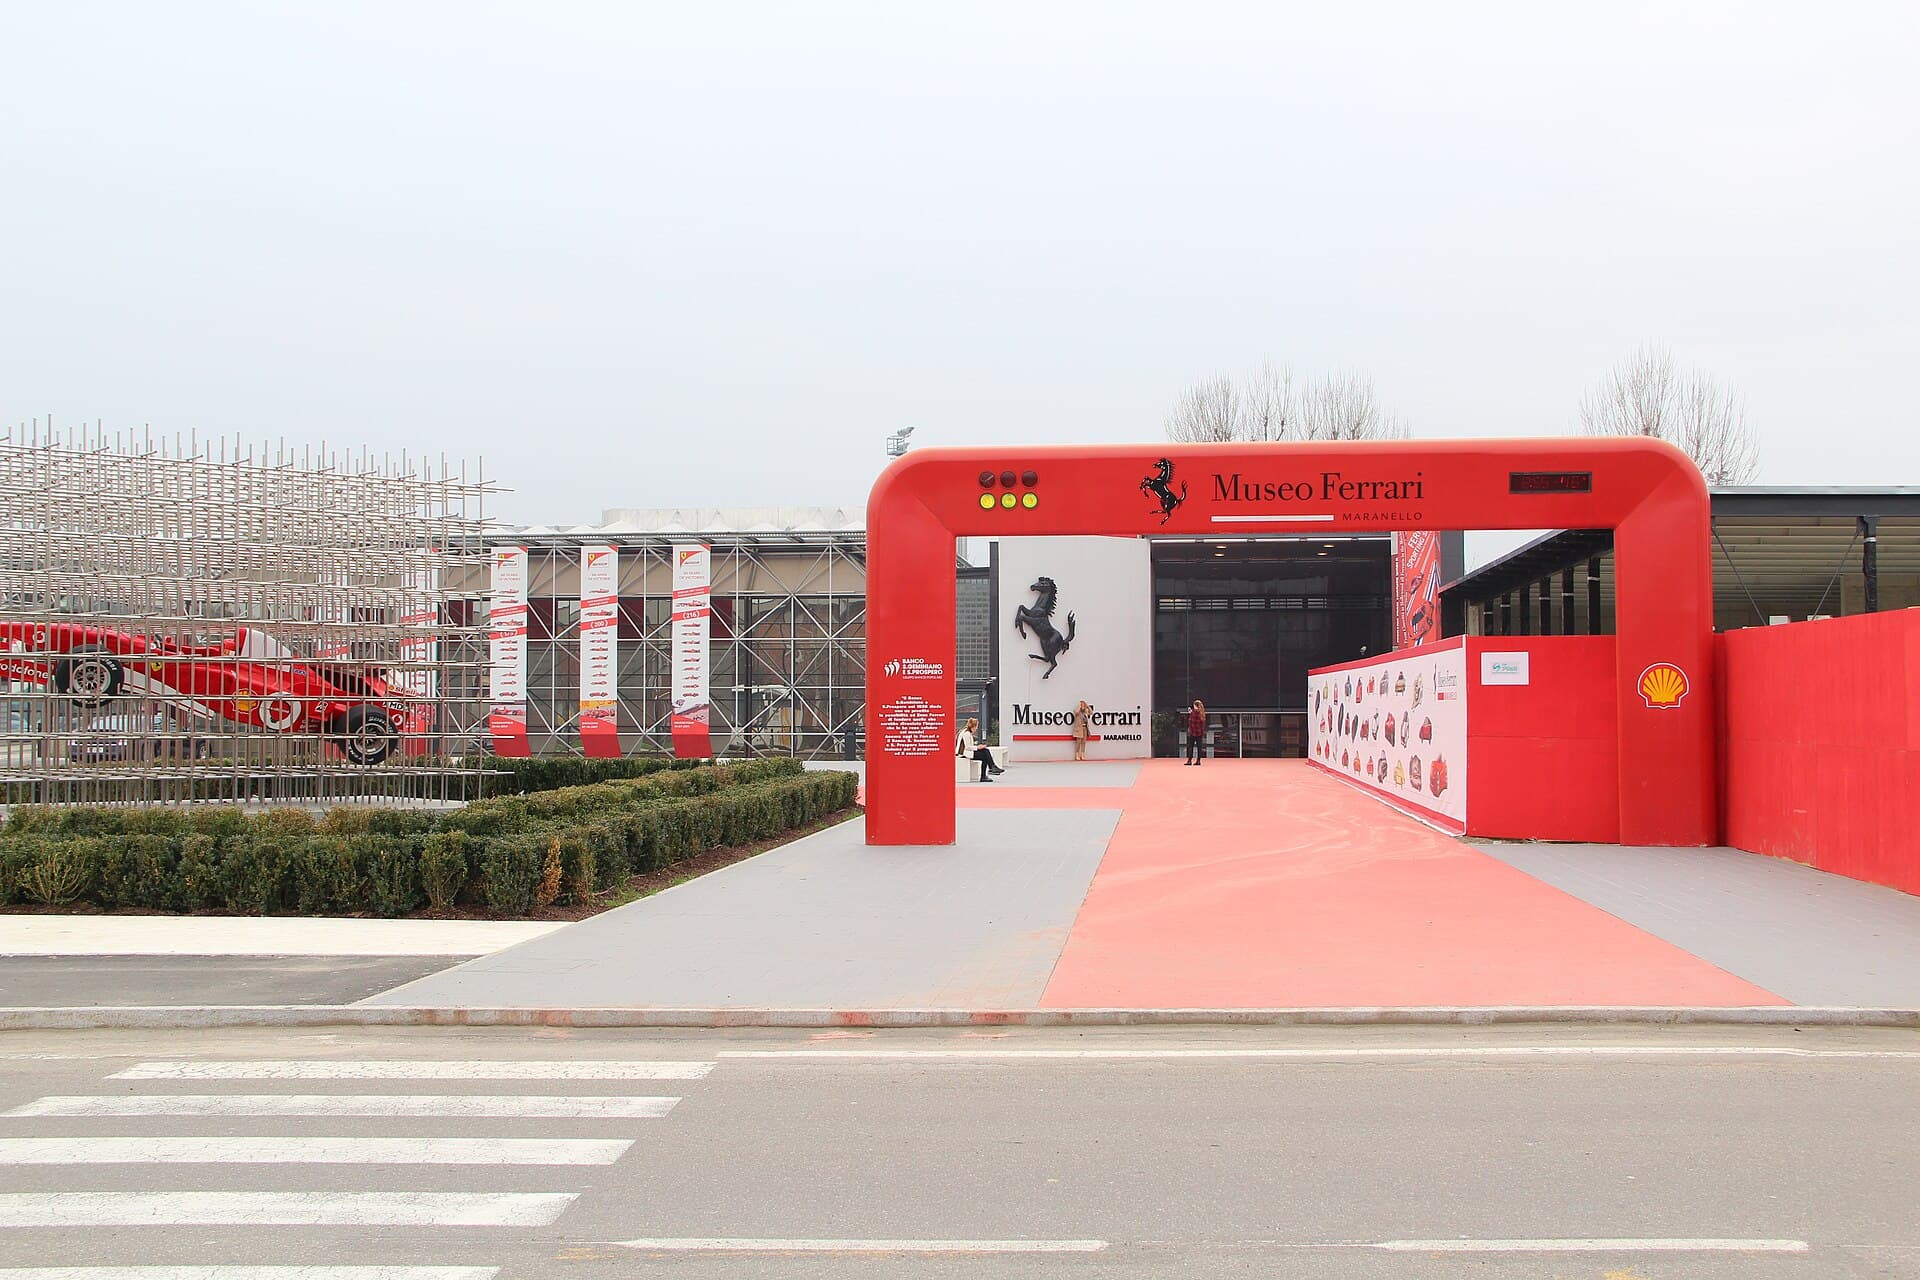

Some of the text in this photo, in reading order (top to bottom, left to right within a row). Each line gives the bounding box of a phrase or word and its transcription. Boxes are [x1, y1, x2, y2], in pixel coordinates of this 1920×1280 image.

[1211, 472, 1424, 501] Museo Ferrari
[1342, 511, 1423, 521] MARANELLO
[0, 662, 49, 679] odafone
[1012, 704, 1141, 726] Museo errari
